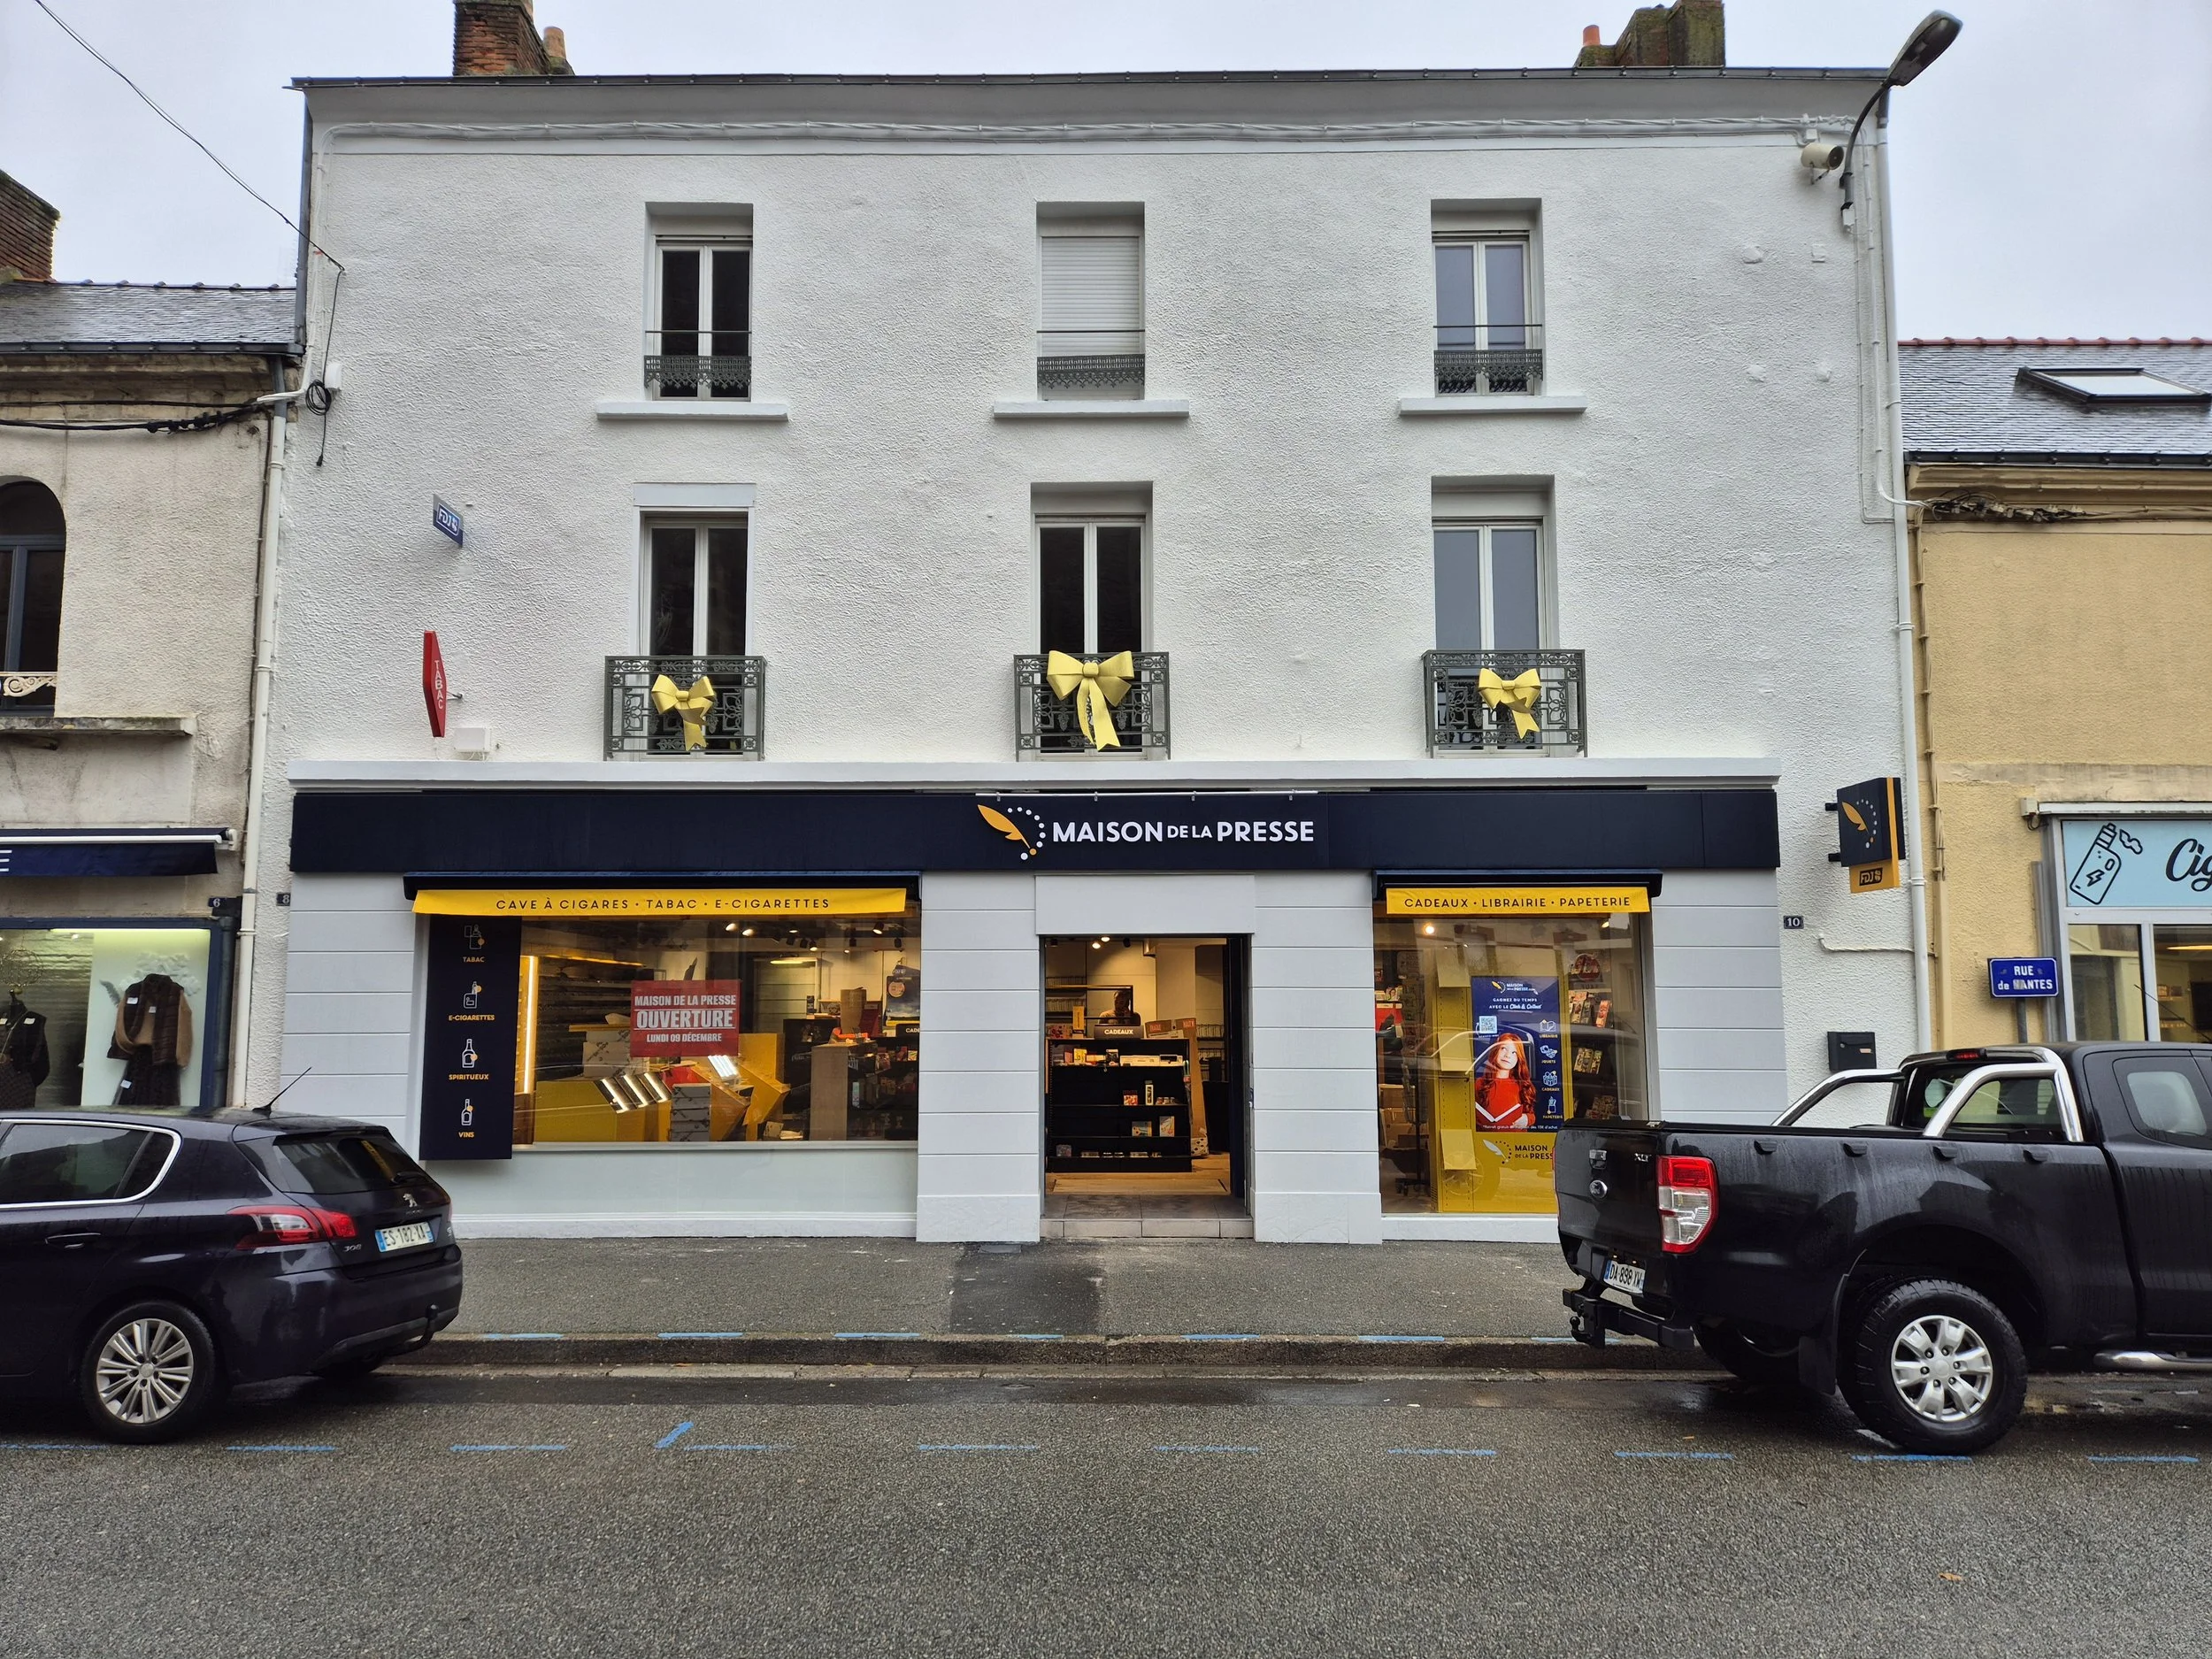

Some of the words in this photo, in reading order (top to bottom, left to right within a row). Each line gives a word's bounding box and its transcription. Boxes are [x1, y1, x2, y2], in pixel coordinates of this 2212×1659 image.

[439, 508, 452, 526] FDJ
[434, 660, 443, 709] TABAC
[1053, 821, 1163, 842] MAISON
[1167, 825, 1188, 838] DE
[1192, 825, 1212, 838] LA
[1217, 821, 1314, 841] PRESSE
[1860, 871, 1874, 884] FDJ
[213, 898, 220, 907] 6
[282, 895, 290, 903] 8
[496, 900, 537, 909] CAVE
[544, 897, 552, 909] À
[559, 899, 628, 909] CIGARES
[647, 899, 697, 909] TABAC
[715, 898, 829, 909] E-CIGARETTES
[1404, 898, 1469, 908] CADEAUX
[1482, 898, 1547, 907] LIBRAIRIE
[1560, 897, 1630, 907] PAPETERIE
[1787, 918, 1801, 926] 10
[2014, 965, 2034, 976] RUE
[1997, 980, 2009, 990] de
[634, 995, 671, 1006] MAISON
[673, 995, 686, 1006] DE
[687, 995, 699, 1005] LA
[701, 995, 736, 1005] PRESSE
[637, 1010, 733, 1028] OUVERTURE
[647, 1033, 669, 1042] LUNDI
[671, 1033, 680, 1042] 09
[682, 1032, 722, 1042] DÉCEMBRE
[343, 1243, 362, 1252] 308
